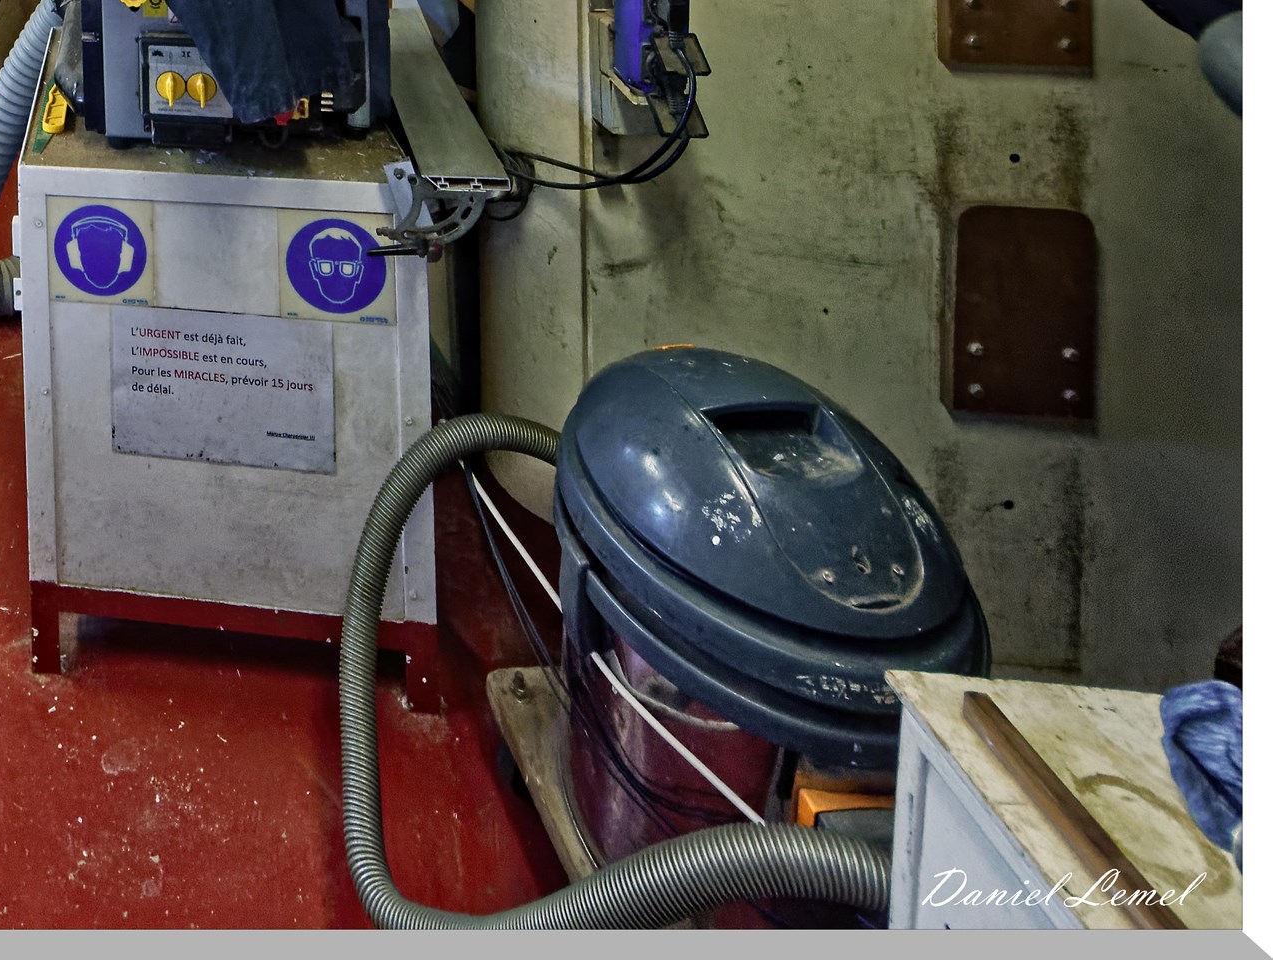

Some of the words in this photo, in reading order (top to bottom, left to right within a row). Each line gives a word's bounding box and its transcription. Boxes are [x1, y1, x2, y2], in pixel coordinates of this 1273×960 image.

[184, 332, 199, 342] est
[202, 331, 224, 346] déjà
[226, 335, 247, 347] fait,
[202, 353, 218, 363] est
[220, 355, 233, 364] en
[236, 357, 267, 368] cours,
[131, 366, 155, 377] Pour
[157, 367, 172, 378] les
[174, 369, 228, 385] MIRACLES,
[231, 374, 269, 390] prévoir
[271, 378, 284, 388] 15
[286, 379, 314, 392] jours
[131, 382, 144, 392] de
[147, 383, 174, 395] délai.
